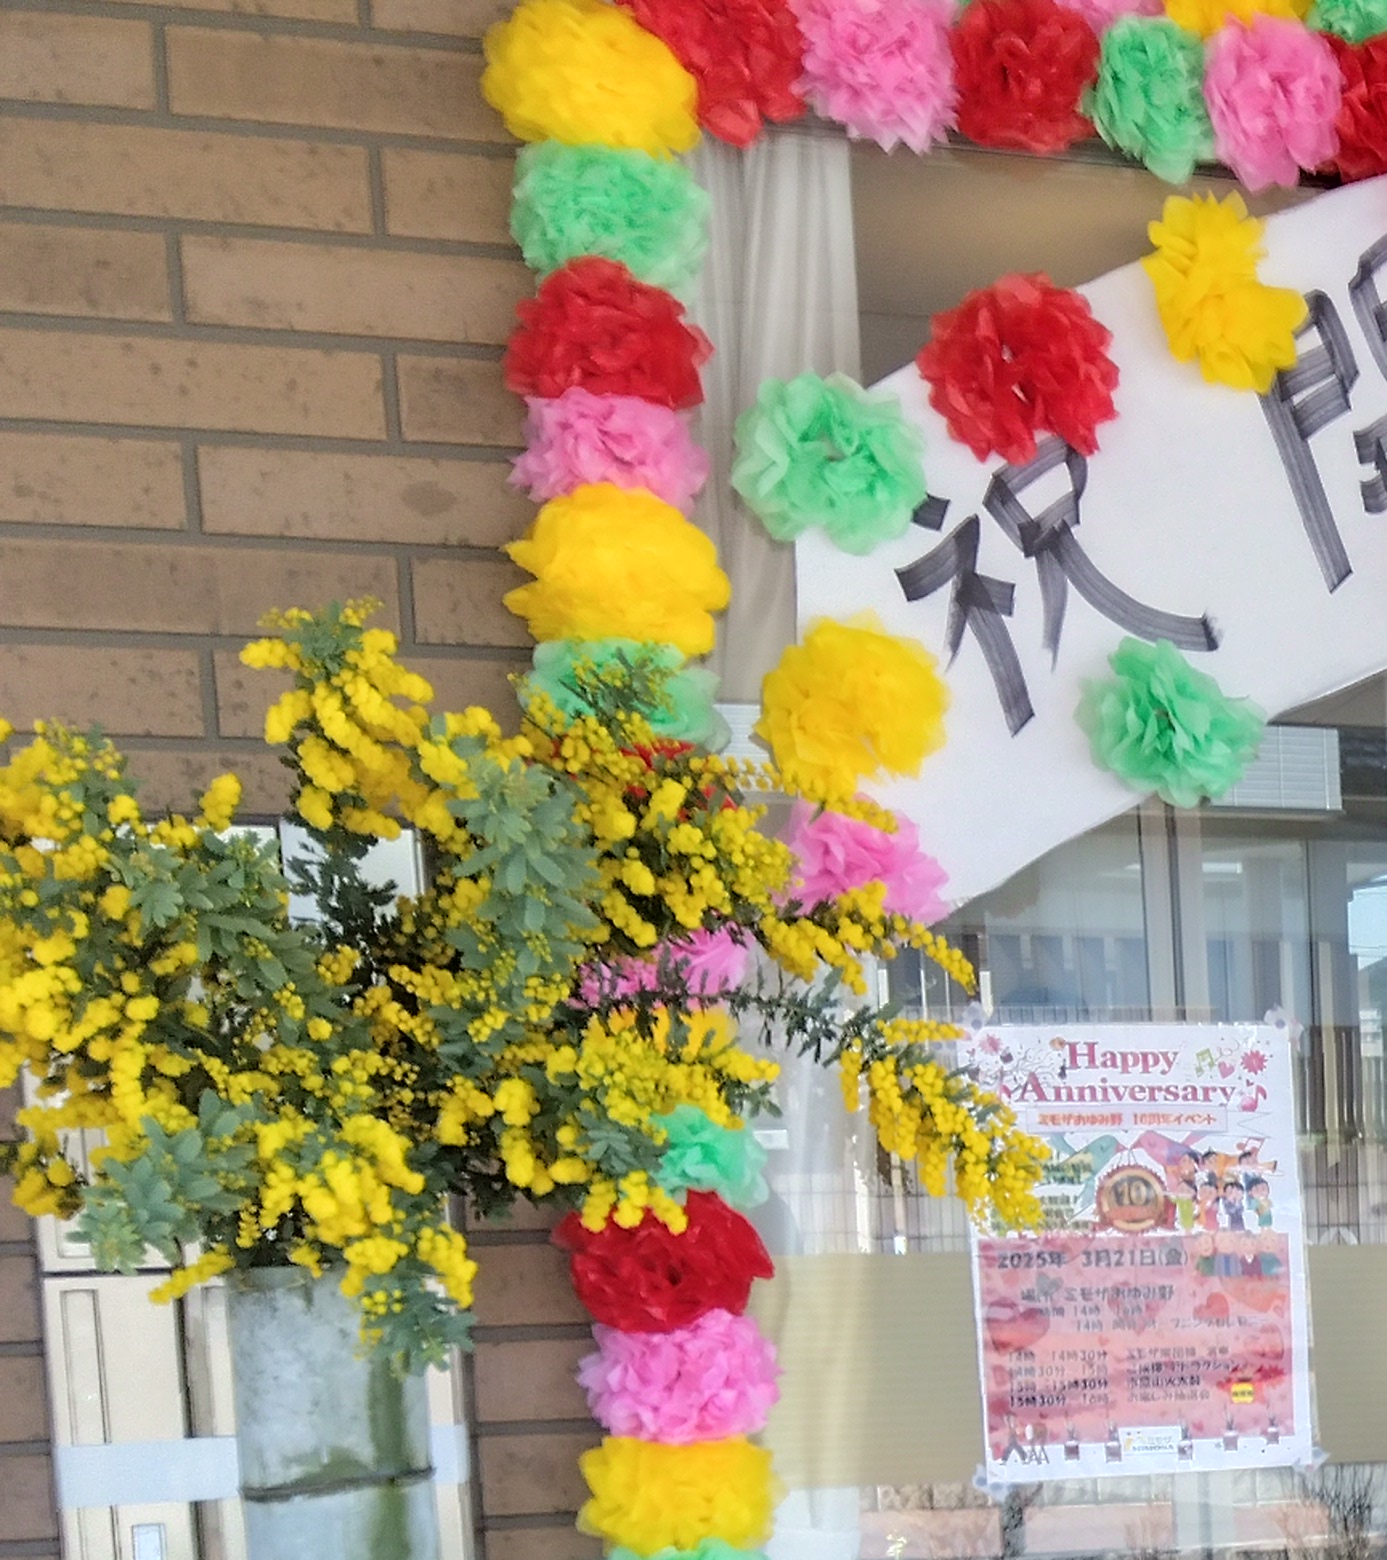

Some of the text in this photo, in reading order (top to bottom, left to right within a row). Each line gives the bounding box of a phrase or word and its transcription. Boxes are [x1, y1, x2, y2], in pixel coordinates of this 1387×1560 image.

[1064, 1041, 1179, 1075] Happy
[1015, 1071, 1236, 1106] Anniversary
[997, 1250, 1067, 1270] 2025年
